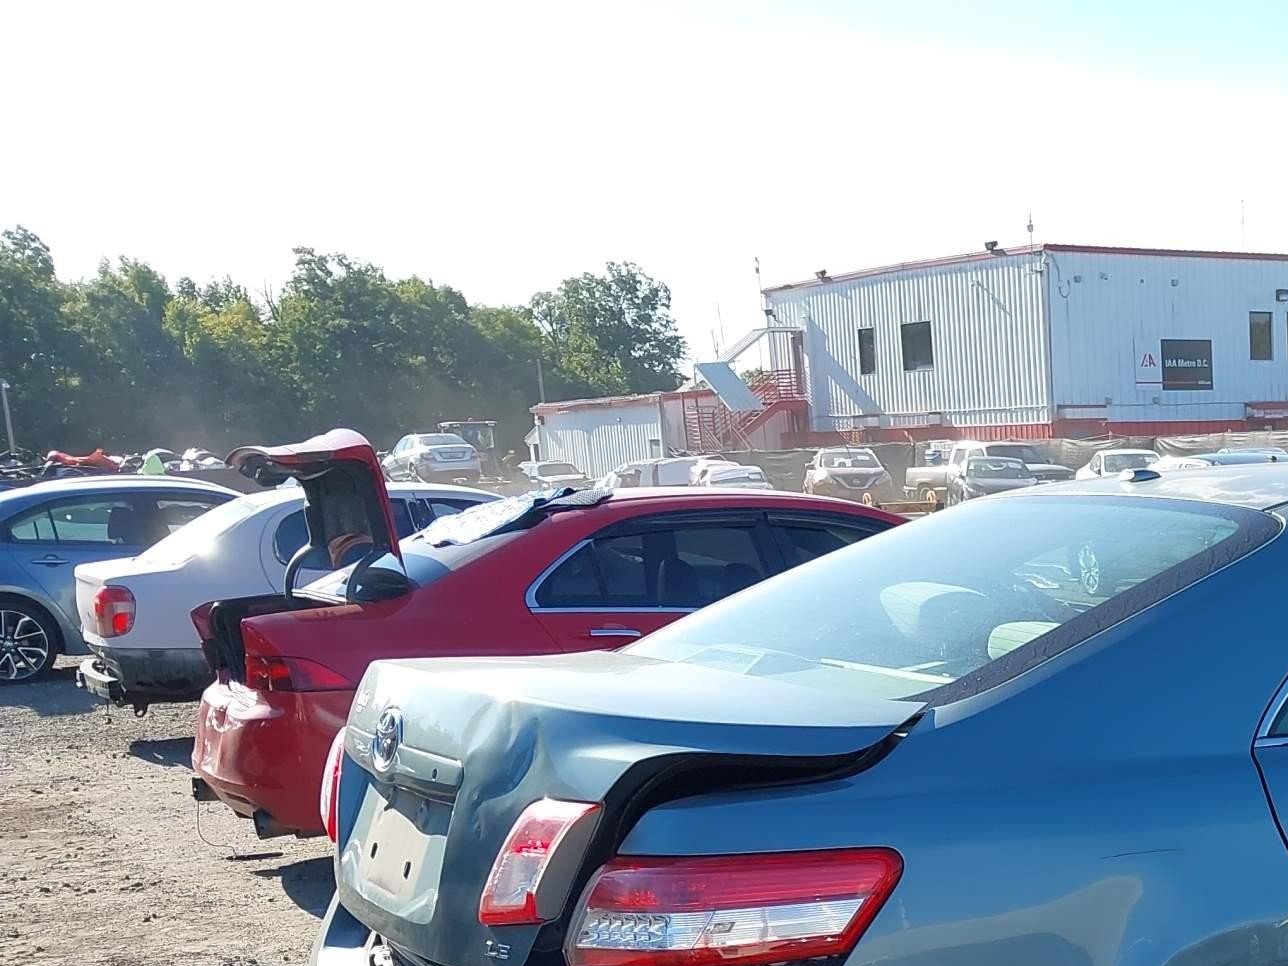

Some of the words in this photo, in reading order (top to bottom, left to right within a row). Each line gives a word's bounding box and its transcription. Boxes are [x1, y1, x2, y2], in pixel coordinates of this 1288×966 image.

[1165, 359, 1178, 368] IAA
[1178, 359, 1196, 368] Metro
[484, 940, 512, 960] LE
